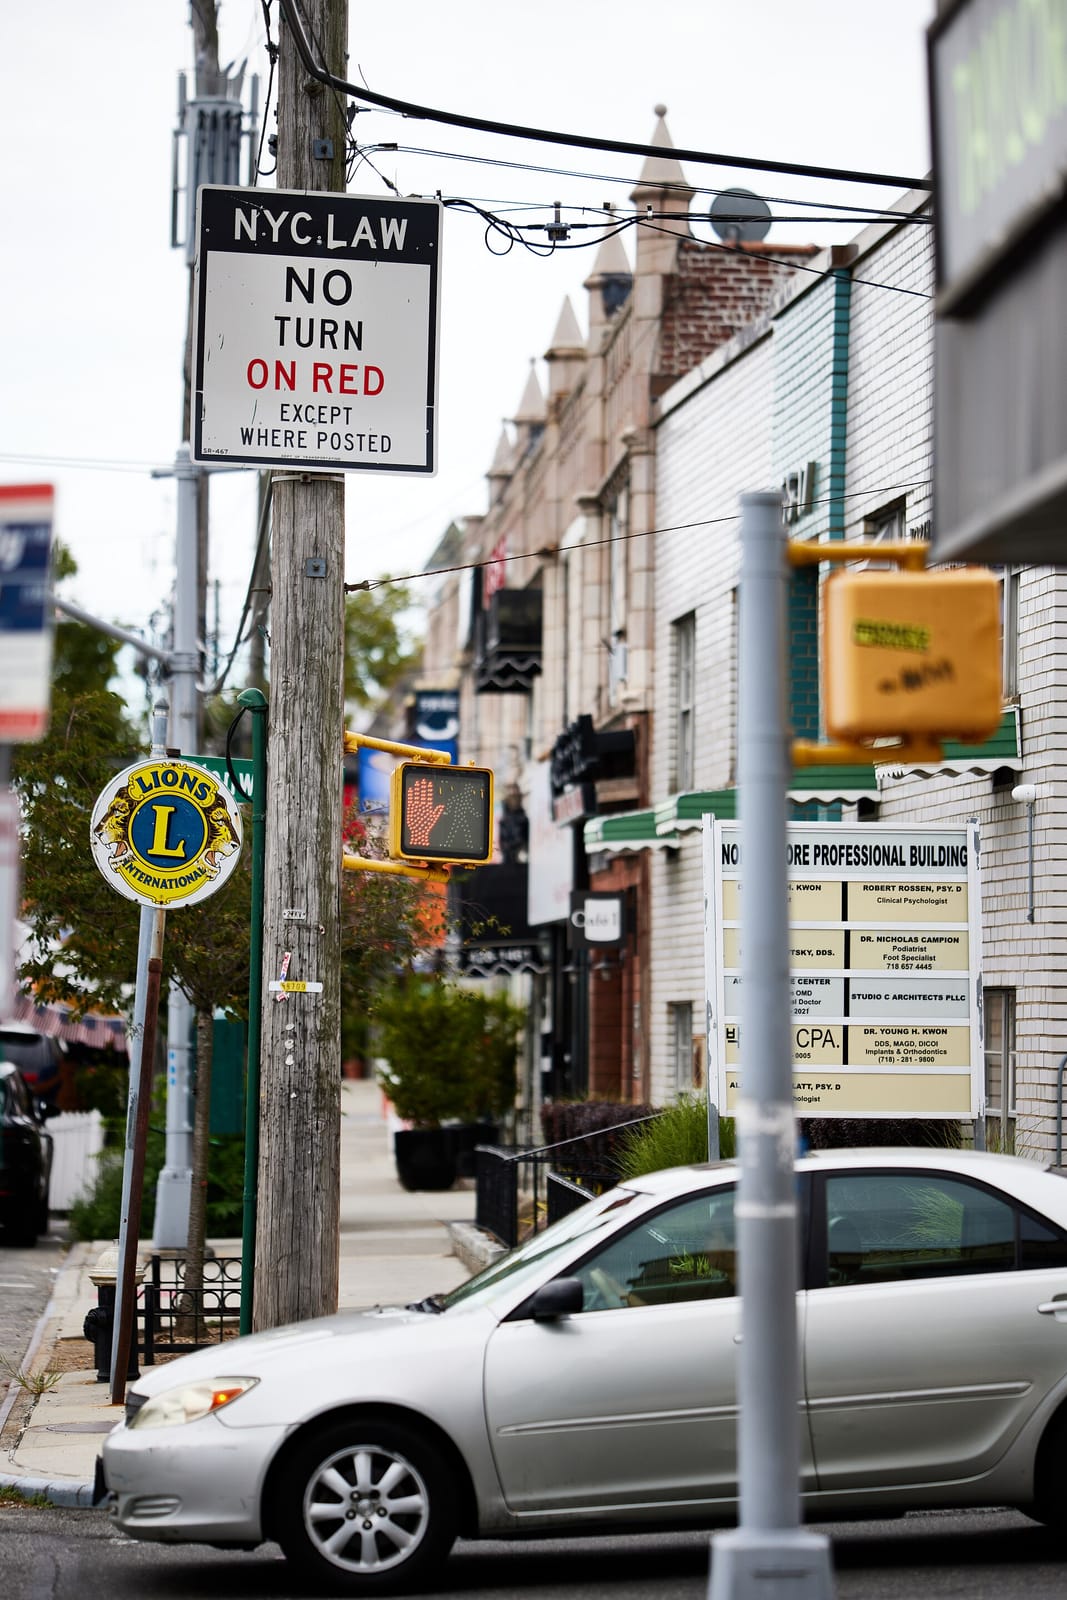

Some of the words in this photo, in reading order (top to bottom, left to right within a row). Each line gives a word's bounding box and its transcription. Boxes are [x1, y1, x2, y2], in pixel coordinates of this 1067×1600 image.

[327, 214, 408, 251] LAW
[285, 266, 352, 306] NO
[274, 315, 363, 351] TURN
[247, 358, 296, 391] ON
[312, 362, 385, 396] RED
[280, 403, 353, 425] EXCEPT
[240, 427, 308, 449] WHERE
[317, 431, 392, 453] POSTED
[136, 769, 211, 800] LIONS
[147, 805, 187, 858] L
[813, 844, 906, 867] PROFESSIONAL
[910, 845, 968, 867] BUILDING
[122, 858, 207, 889] INTERNATIONAL
[863, 884, 896, 892] ROBERT
[898, 885, 934, 893] ROSSEN,
[903, 897, 948, 905] Psychologist
[901, 954, 936, 962] Specialist
[796, 1028, 840, 1049] CPA.
[865, 1048, 895, 1056] Implants
[878, 1056, 895, 1064] (718)
